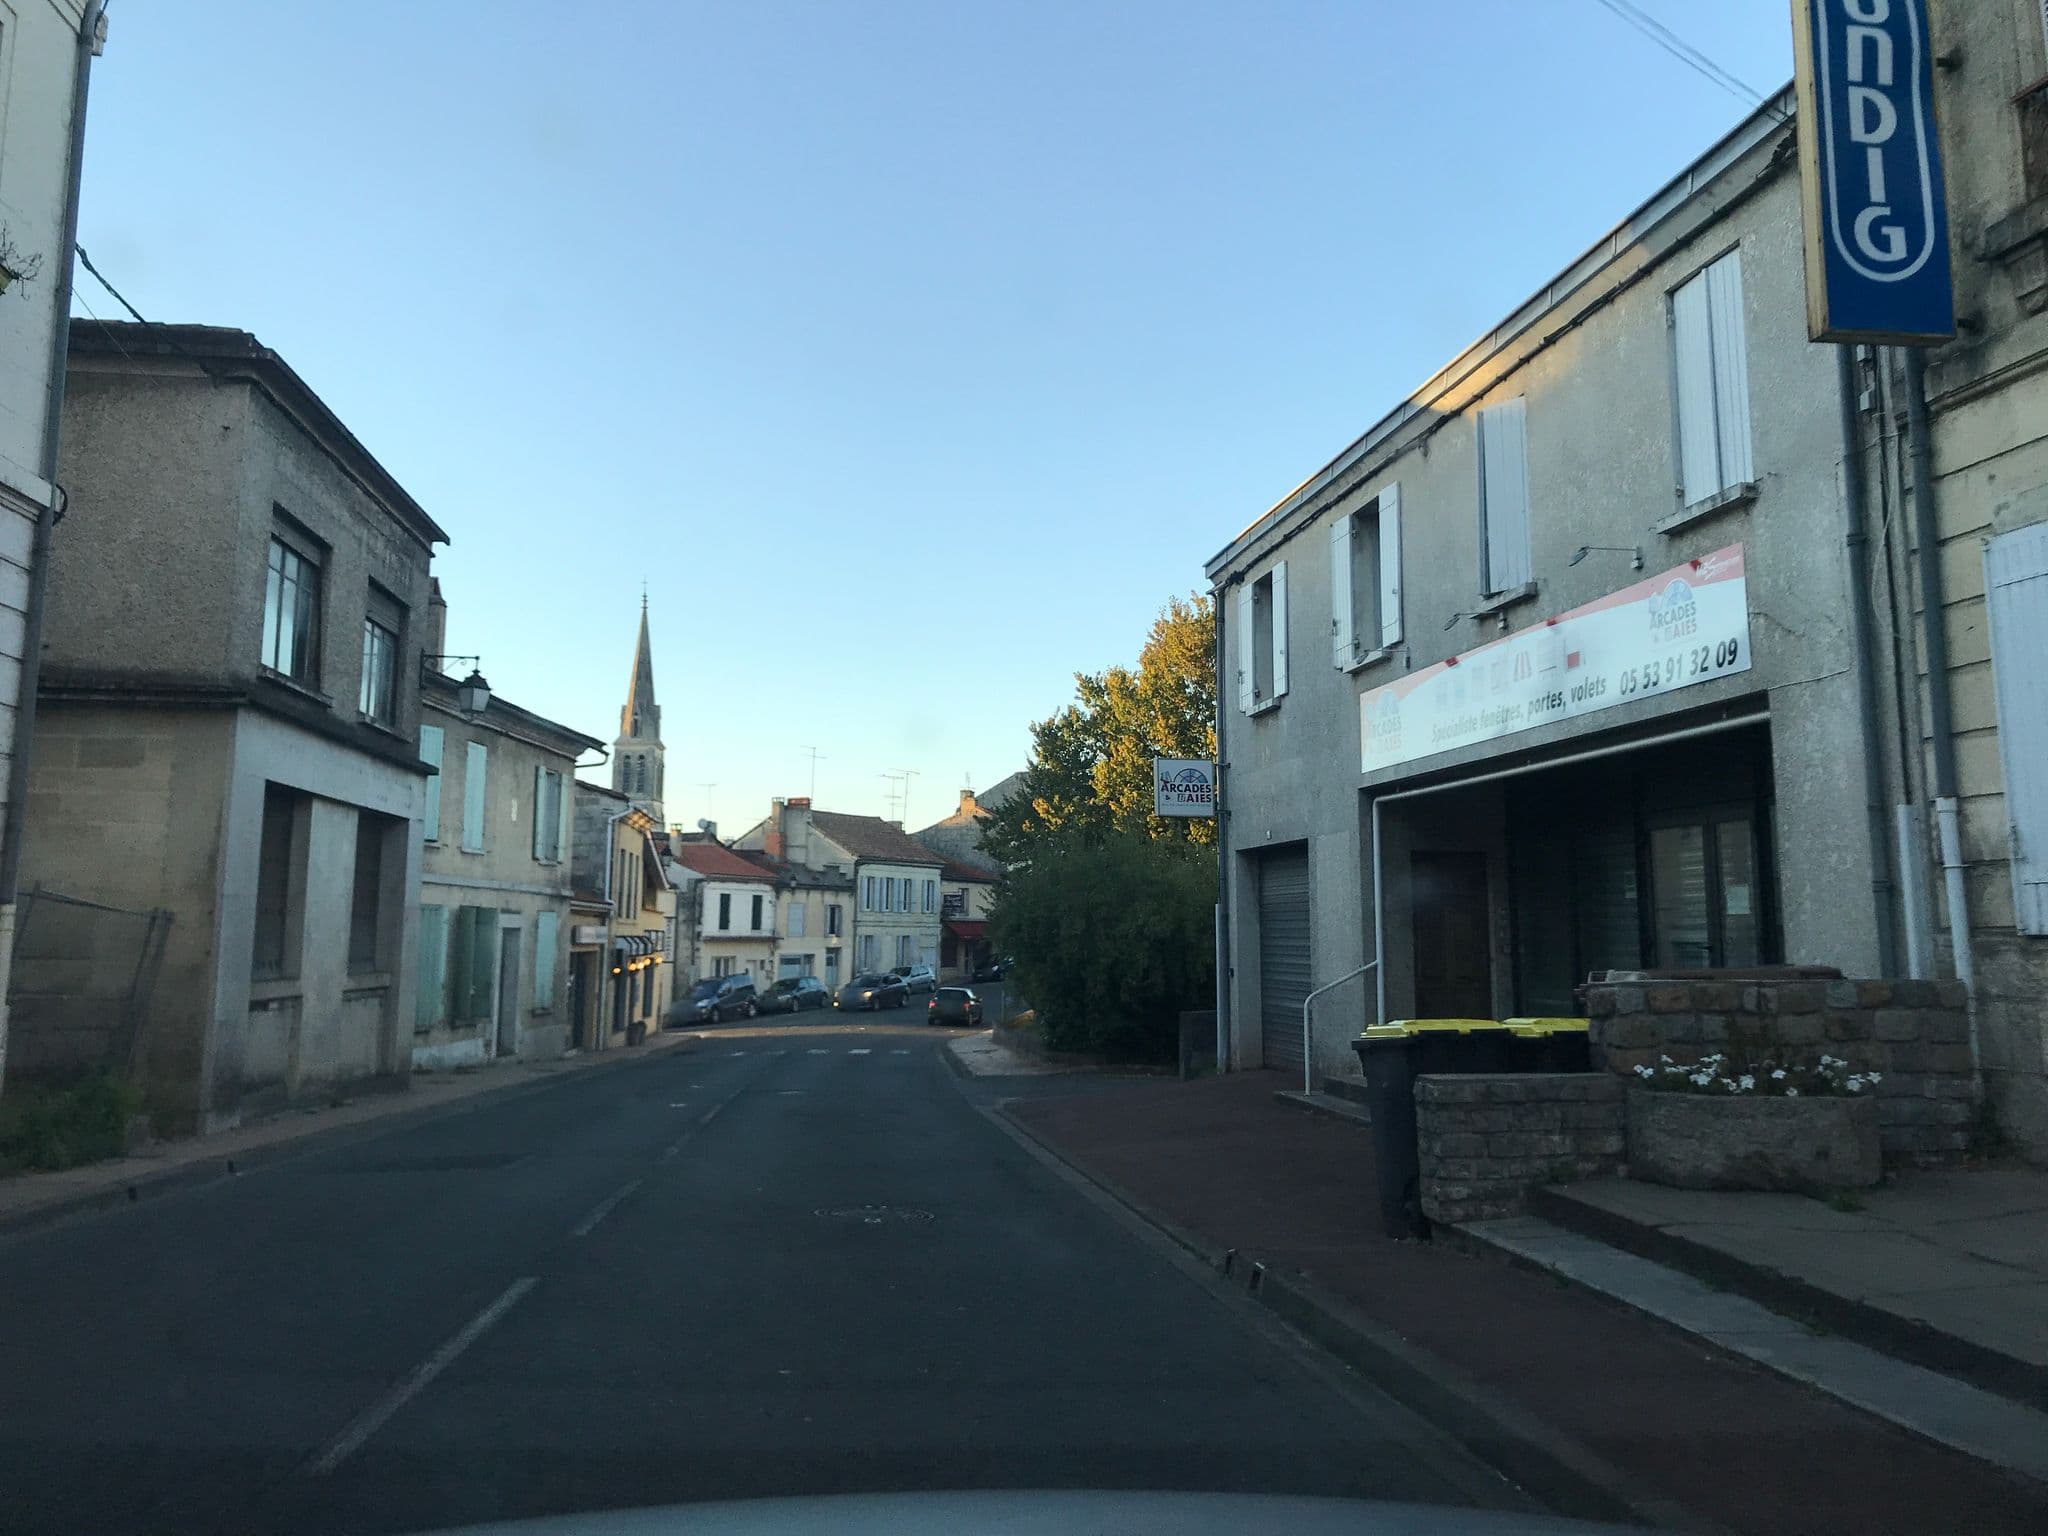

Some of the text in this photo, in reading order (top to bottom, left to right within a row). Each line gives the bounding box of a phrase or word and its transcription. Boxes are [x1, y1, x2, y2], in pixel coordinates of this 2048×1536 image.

[1649, 601, 1697, 629] ARCADES
[1620, 637, 1738, 696] 05 53 91 32 09
[1527, 690, 1566, 721] portes,
[1571, 675, 1606, 703] volets
[1161, 783, 1212, 794] ARCADES
